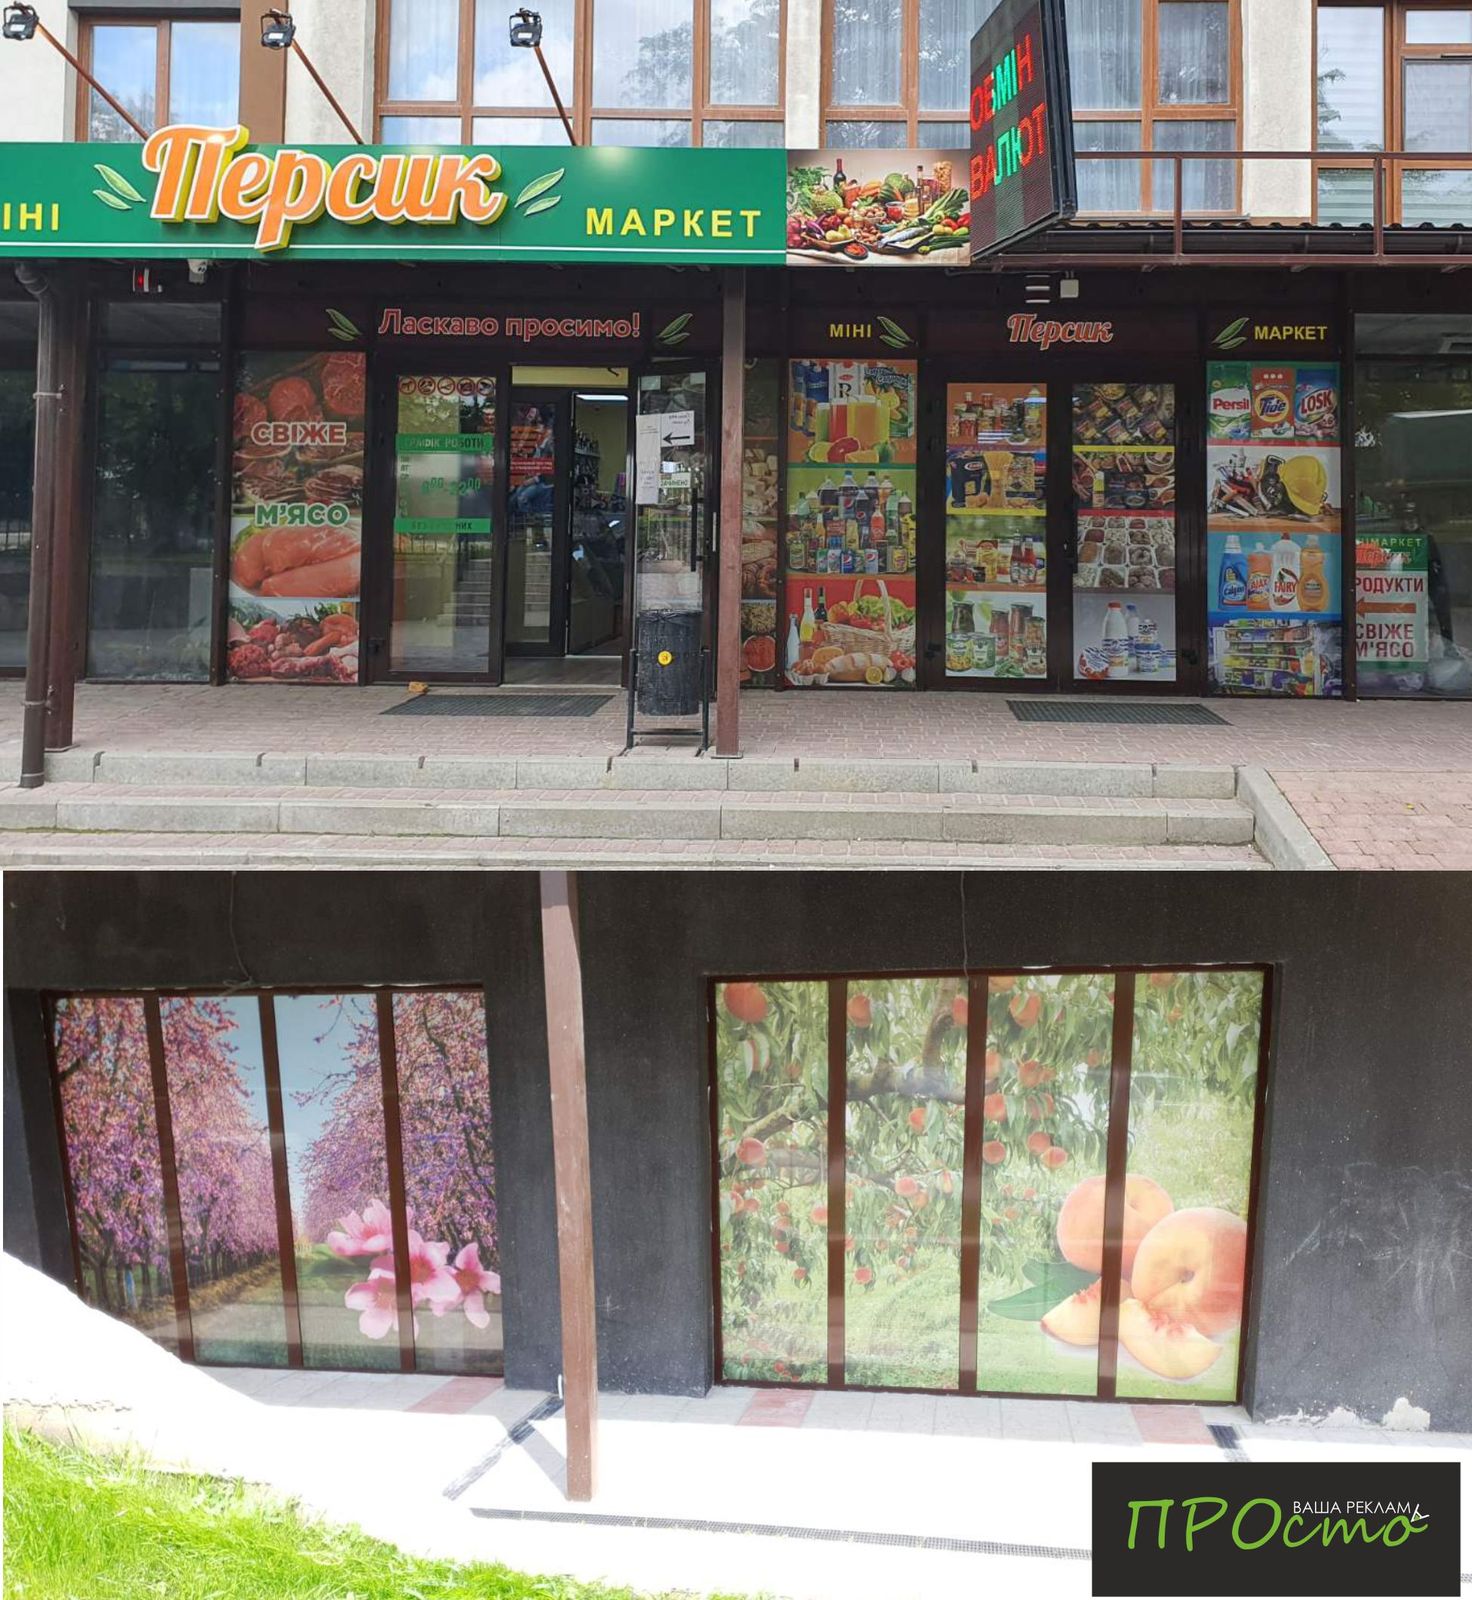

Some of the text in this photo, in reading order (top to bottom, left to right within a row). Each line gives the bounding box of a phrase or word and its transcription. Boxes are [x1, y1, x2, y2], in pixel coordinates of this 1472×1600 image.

[970, 32, 1034, 131] ОБМІН
[970, 102, 1046, 200] ВАЛЮТ
[142, 124, 507, 253] Персик
[2, 203, 60, 231] ІНІ
[585, 208, 762, 238] МАРКЕТ
[377, 308, 641, 340] Ласкаво просимо!
[829, 323, 872, 339] МІНІ
[1007, 313, 1114, 351] Персик
[1253, 326, 1328, 341] МАРКЕТ
[1213, 397, 1250, 410] Persil
[1259, 395, 1287, 416] Tide
[1300, 389, 1332, 414] LOSK
[251, 421, 347, 446] СВІЖЕ
[1356, 577, 1424, 593] РОДУКТИ
